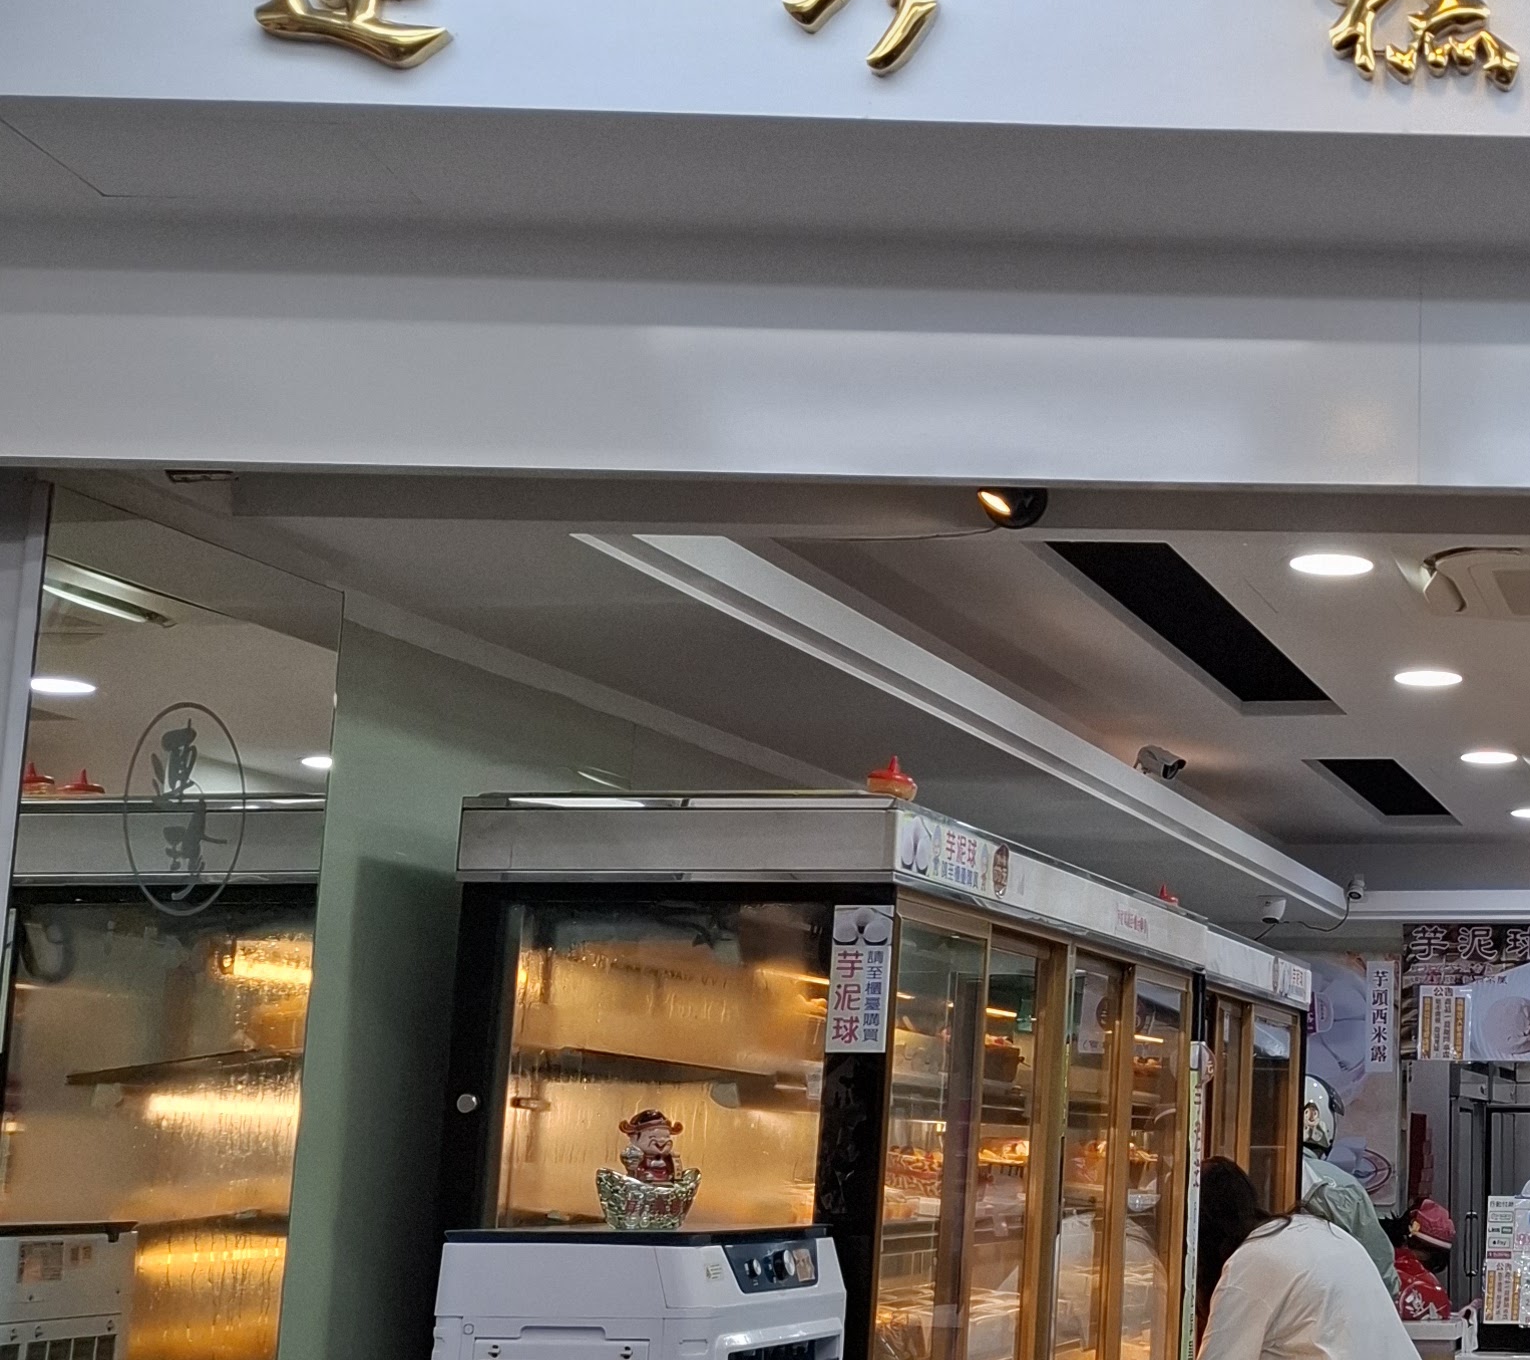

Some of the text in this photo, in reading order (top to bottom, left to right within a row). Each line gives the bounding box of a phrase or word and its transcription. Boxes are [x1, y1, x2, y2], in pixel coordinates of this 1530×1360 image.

[945, 830, 977, 869] 芋泥球
[831, 950, 864, 1044] 芋泥球
[1370, 970, 1389, 1063] 芋頭西米露
